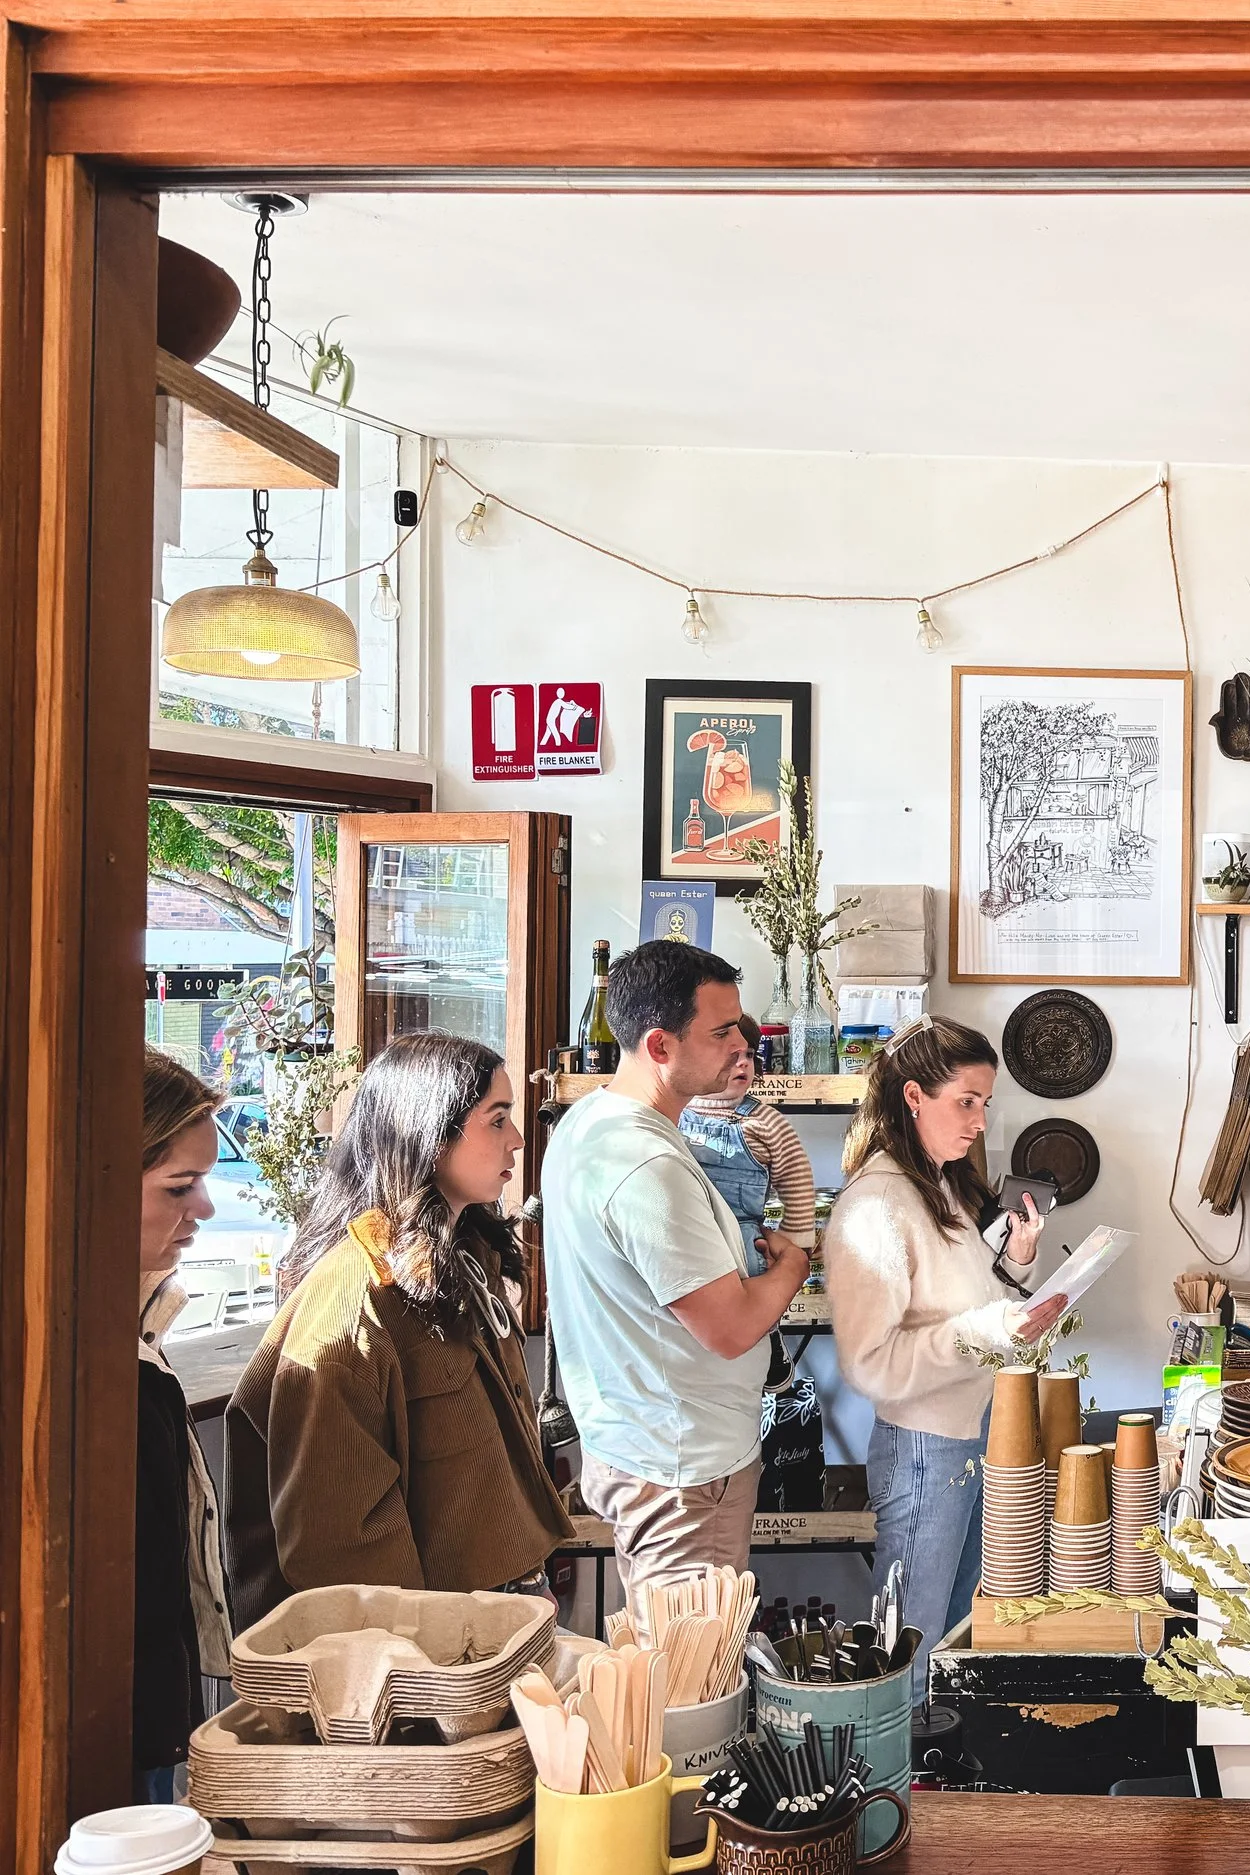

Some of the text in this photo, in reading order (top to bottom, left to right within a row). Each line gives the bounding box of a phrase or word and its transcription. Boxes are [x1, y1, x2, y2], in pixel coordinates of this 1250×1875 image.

[700, 717, 755, 730] APEROL
[494, 755, 513, 763] FIRE
[539, 755, 595, 765] FIRE BLANKET
[474, 764, 534, 774] EXTINGUISHER
[649, 889, 708, 899] queen Ester
[750, 1079, 803, 1089] FRANCE
[755, 1518, 807, 1529] FRANCE
[760, 1688, 792, 1706] roccan
[684, 1735, 737, 1771] KNIVES
